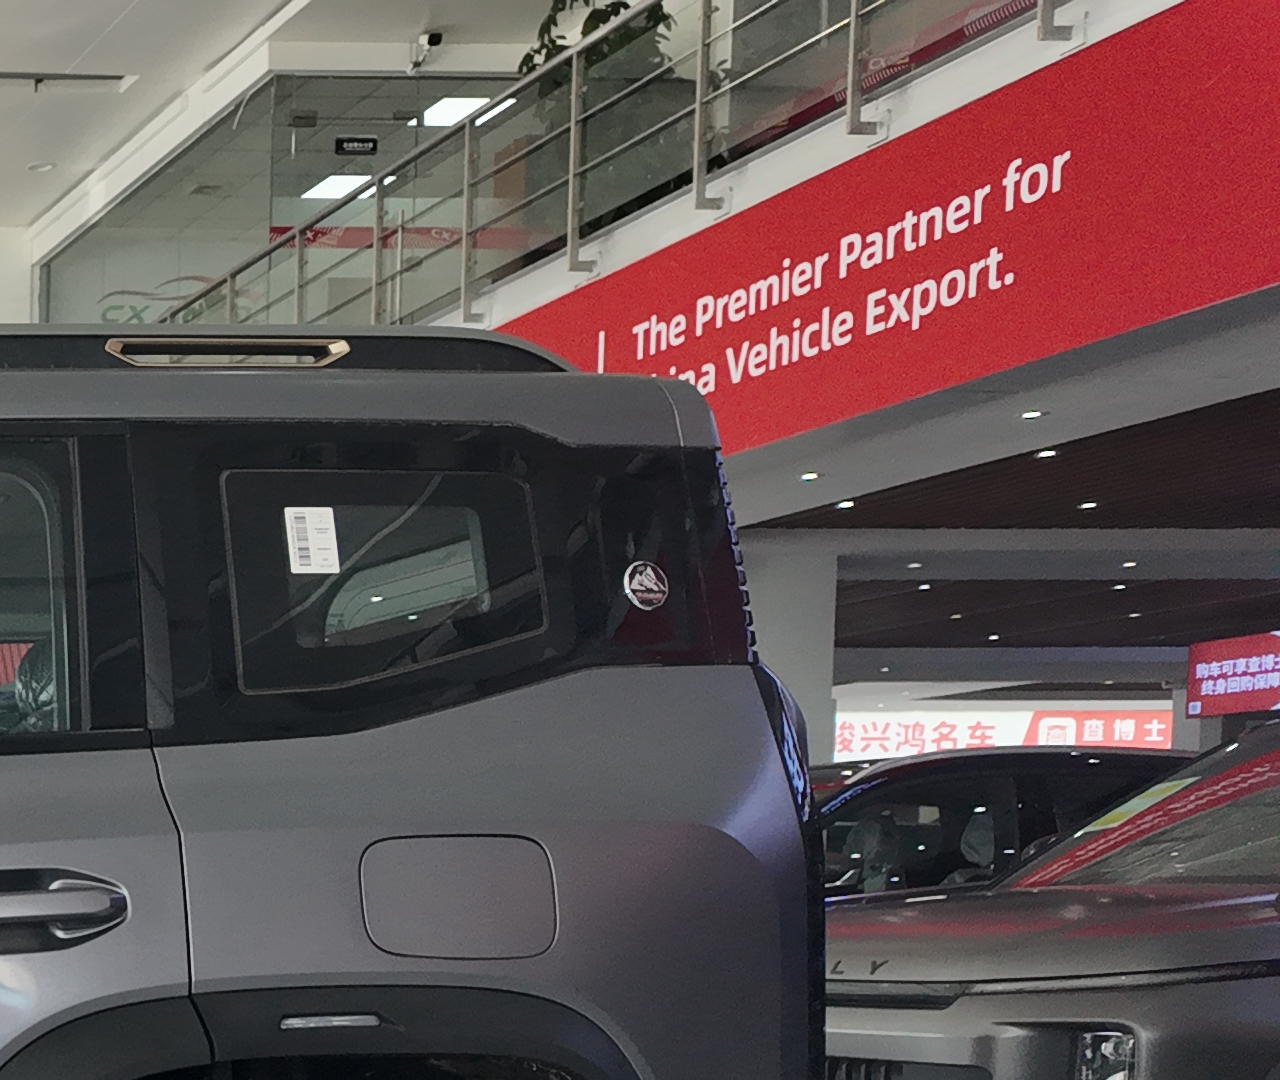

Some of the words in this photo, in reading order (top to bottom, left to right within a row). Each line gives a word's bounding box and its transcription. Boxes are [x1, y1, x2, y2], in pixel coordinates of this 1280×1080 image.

[632, 314, 686, 361] The
[695, 251, 829, 338] Premier
[839, 183, 991, 278] Partner
[1001, 150, 1072, 211] for
[725, 305, 854, 385] Vehicle
[864, 246, 1016, 335] Export.
[1082, 718, 1167, 742] 查博士
